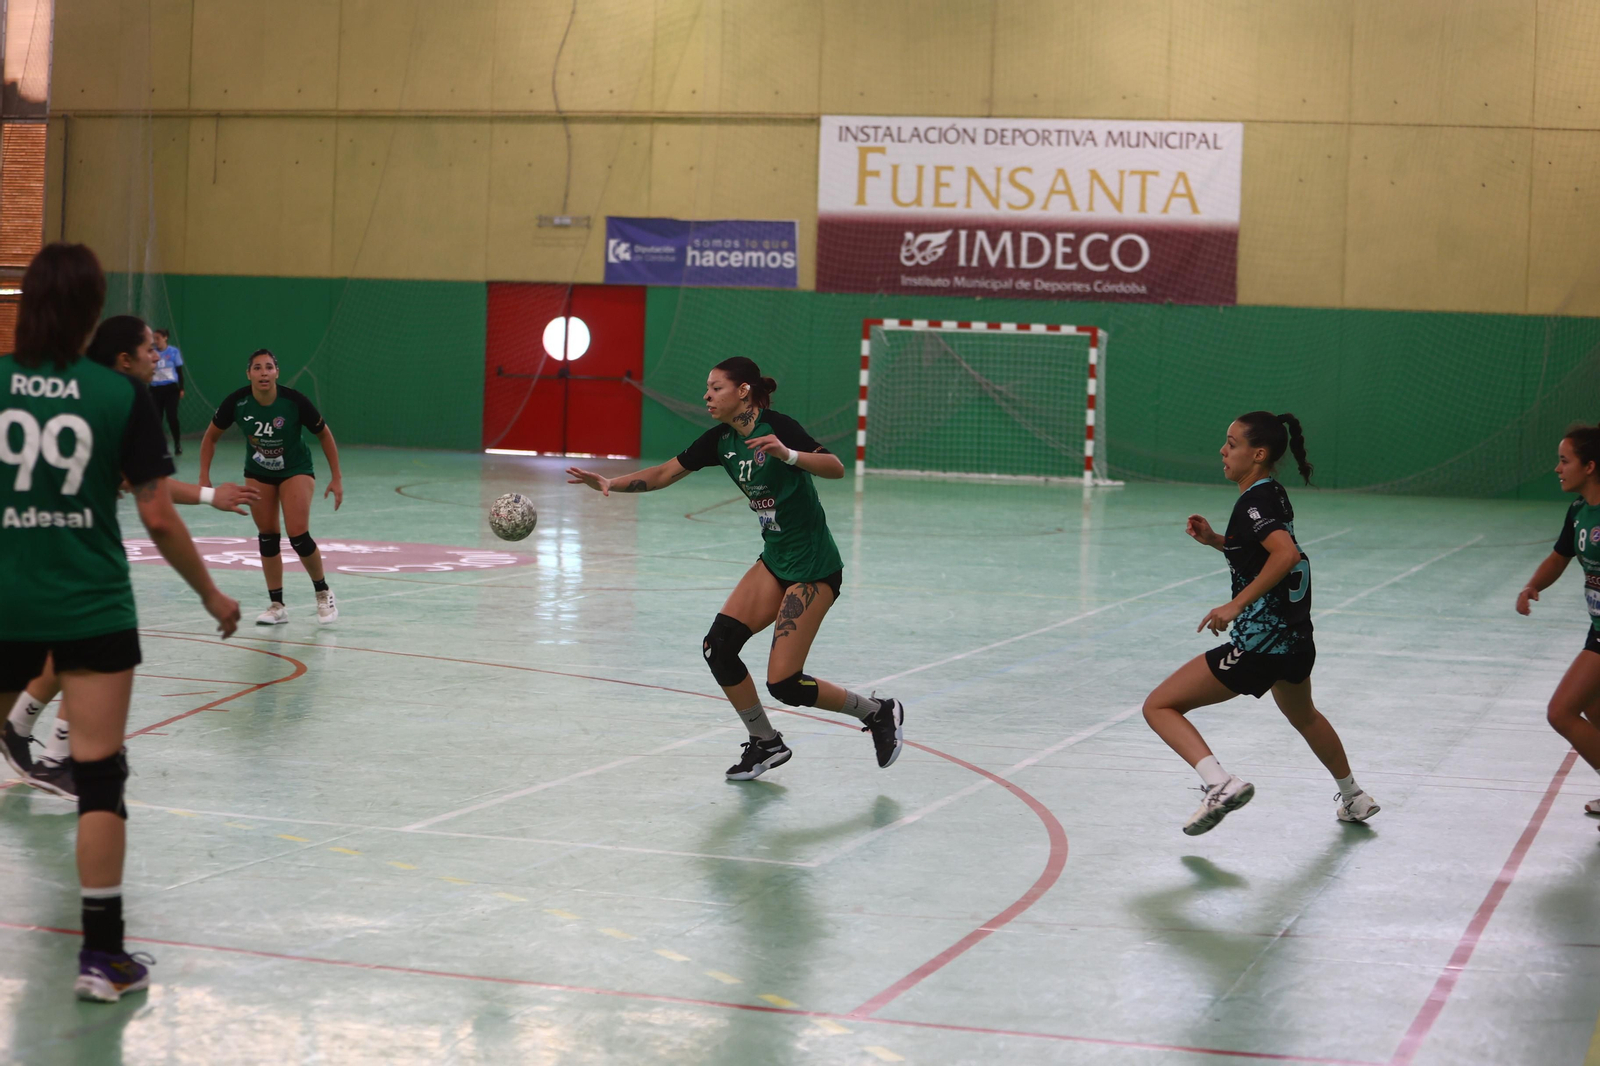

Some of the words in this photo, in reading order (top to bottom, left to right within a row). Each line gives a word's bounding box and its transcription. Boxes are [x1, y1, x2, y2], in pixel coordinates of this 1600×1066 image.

[838, 123, 977, 145] INSTALACIÓN
[984, 127, 1098, 148] DEPORTIVA
[1105, 130, 1223, 151] MUNICIPAL
[854, 146, 1201, 215] FUENSANTA
[693, 238, 740, 249] somos
[957, 229, 1151, 273] IMDECO
[686, 246, 796, 269] hacemos
[901, 275, 950, 288] Instituto
[953, 277, 1013, 291] Municipal
[1015, 279, 1032, 290] de
[1034, 280, 1091, 294] Deportes
[1093, 280, 1147, 295] Córdoba
[10, 373, 80, 400] RODA
[254, 421, 274, 437] 24
[0, 408, 93, 496] 99
[738, 460, 753, 482] 27
[2, 506, 93, 529] Adesal
[1578, 528, 1587, 552] 8
